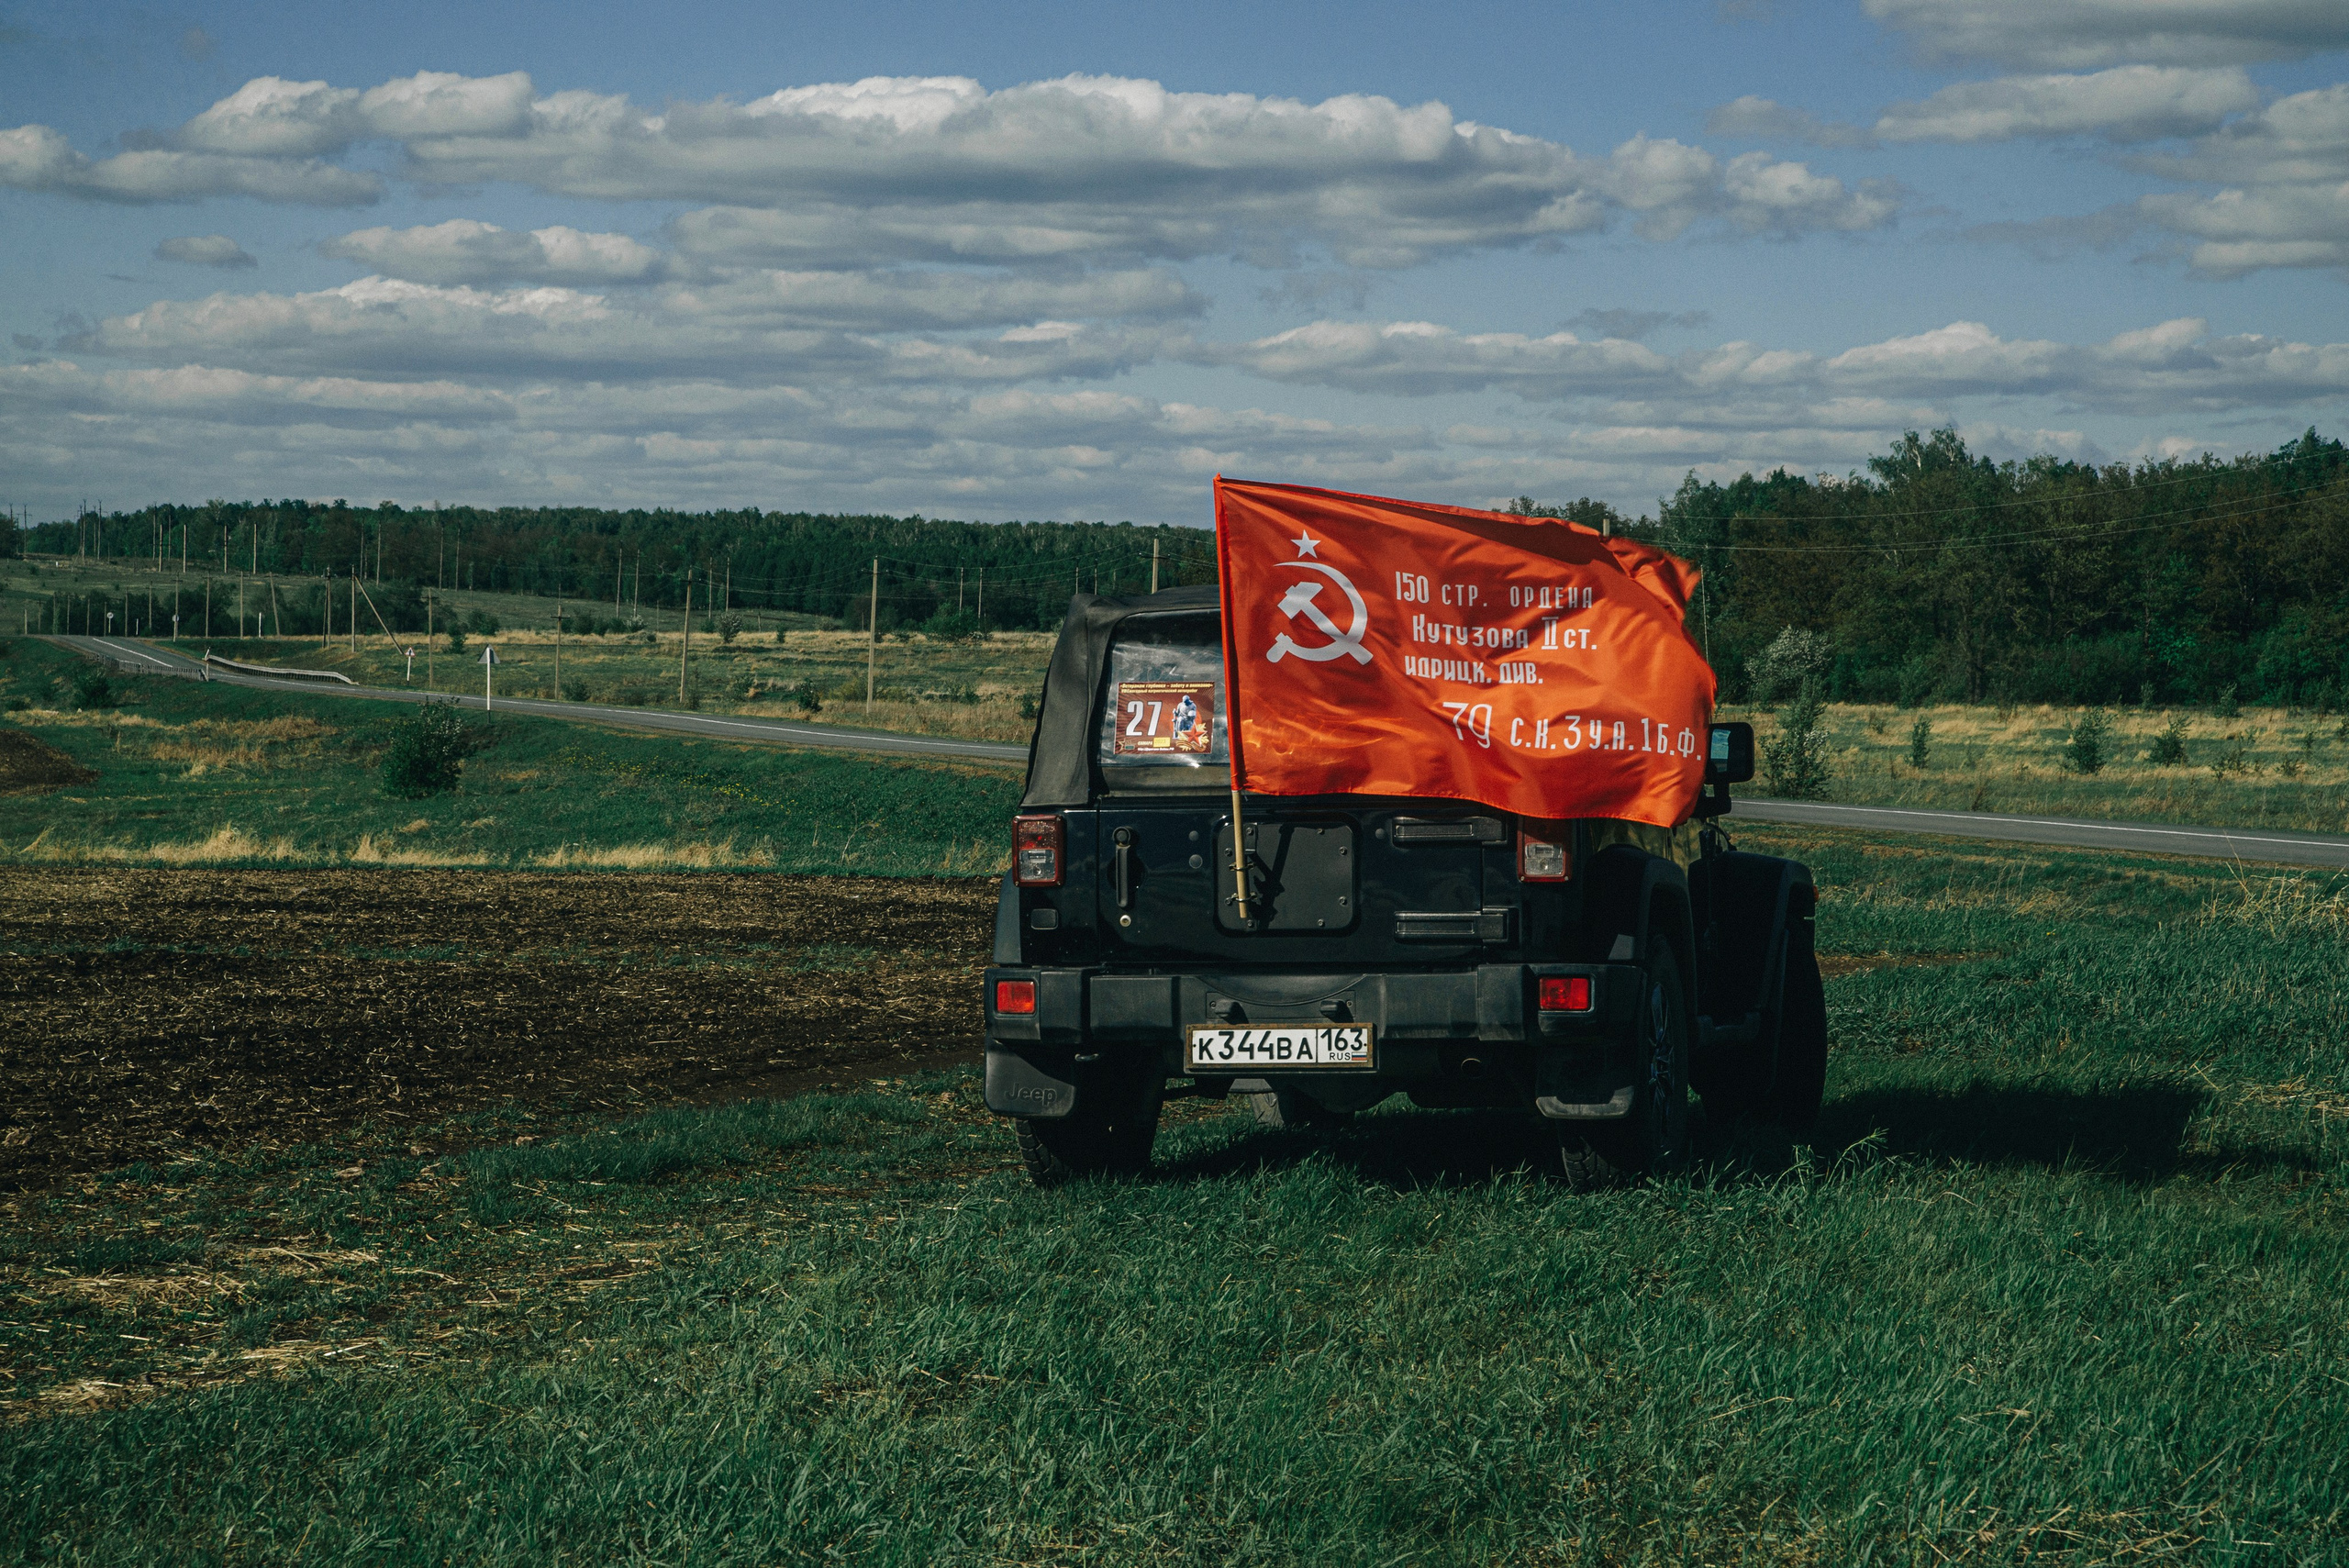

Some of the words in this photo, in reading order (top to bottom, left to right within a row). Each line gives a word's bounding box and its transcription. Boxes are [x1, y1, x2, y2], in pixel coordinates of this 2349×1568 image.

[1395, 571, 1430, 604] 150
[1442, 584, 1487, 607] СТР.
[1509, 585, 1593, 609] ОРДЕНА
[1125, 700, 1163, 737] 27
[1442, 701, 1493, 749] 79
[1198, 1030, 1313, 1061] К344ВА
[1320, 1029, 1363, 1051] 163
[1329, 1052, 1351, 1061] RUS
[1004, 1083, 1057, 1106] Jeep
